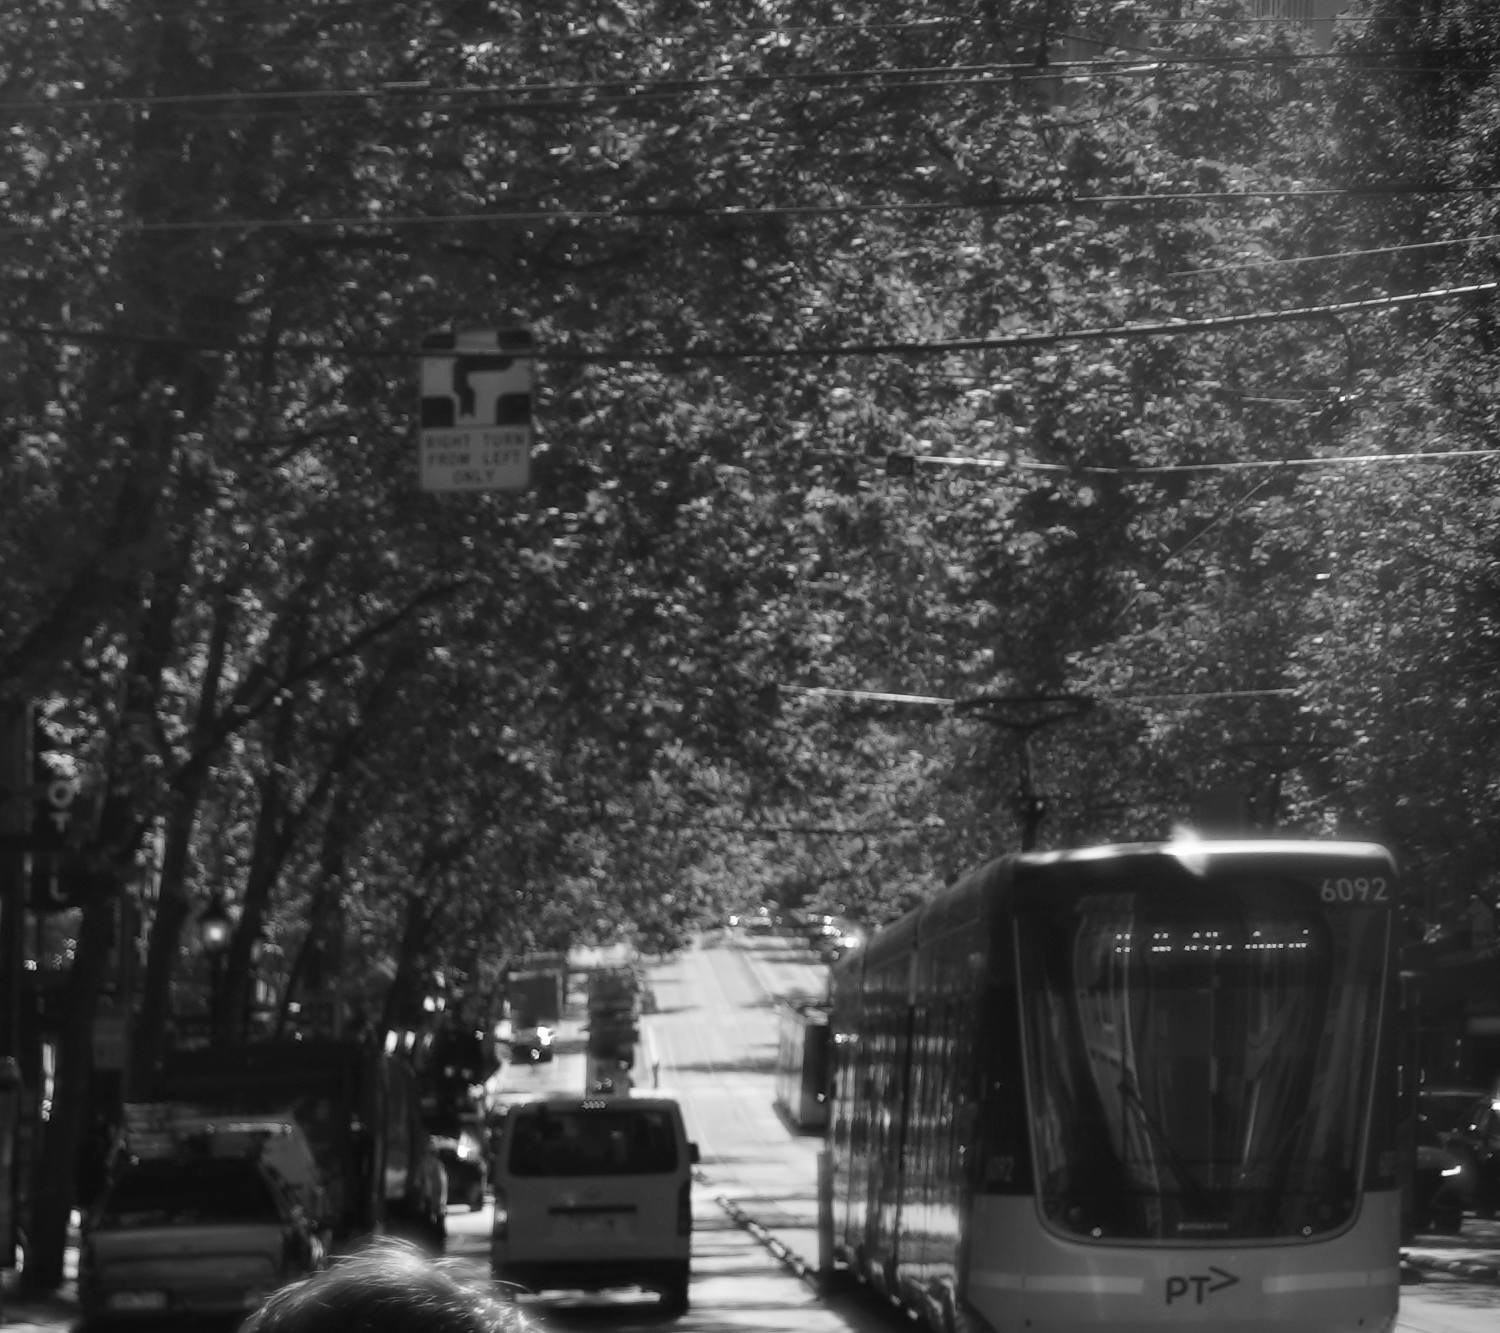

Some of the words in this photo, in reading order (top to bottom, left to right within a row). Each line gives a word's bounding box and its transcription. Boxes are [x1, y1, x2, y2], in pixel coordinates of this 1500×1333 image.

[427, 434, 470, 449] RIGHT
[482, 432, 524, 447] TURN
[427, 452, 470, 467] FROM
[481, 450, 520, 465] LEFT
[452, 470, 495, 485] ONLY
[1321, 878, 1389, 902] 6092
